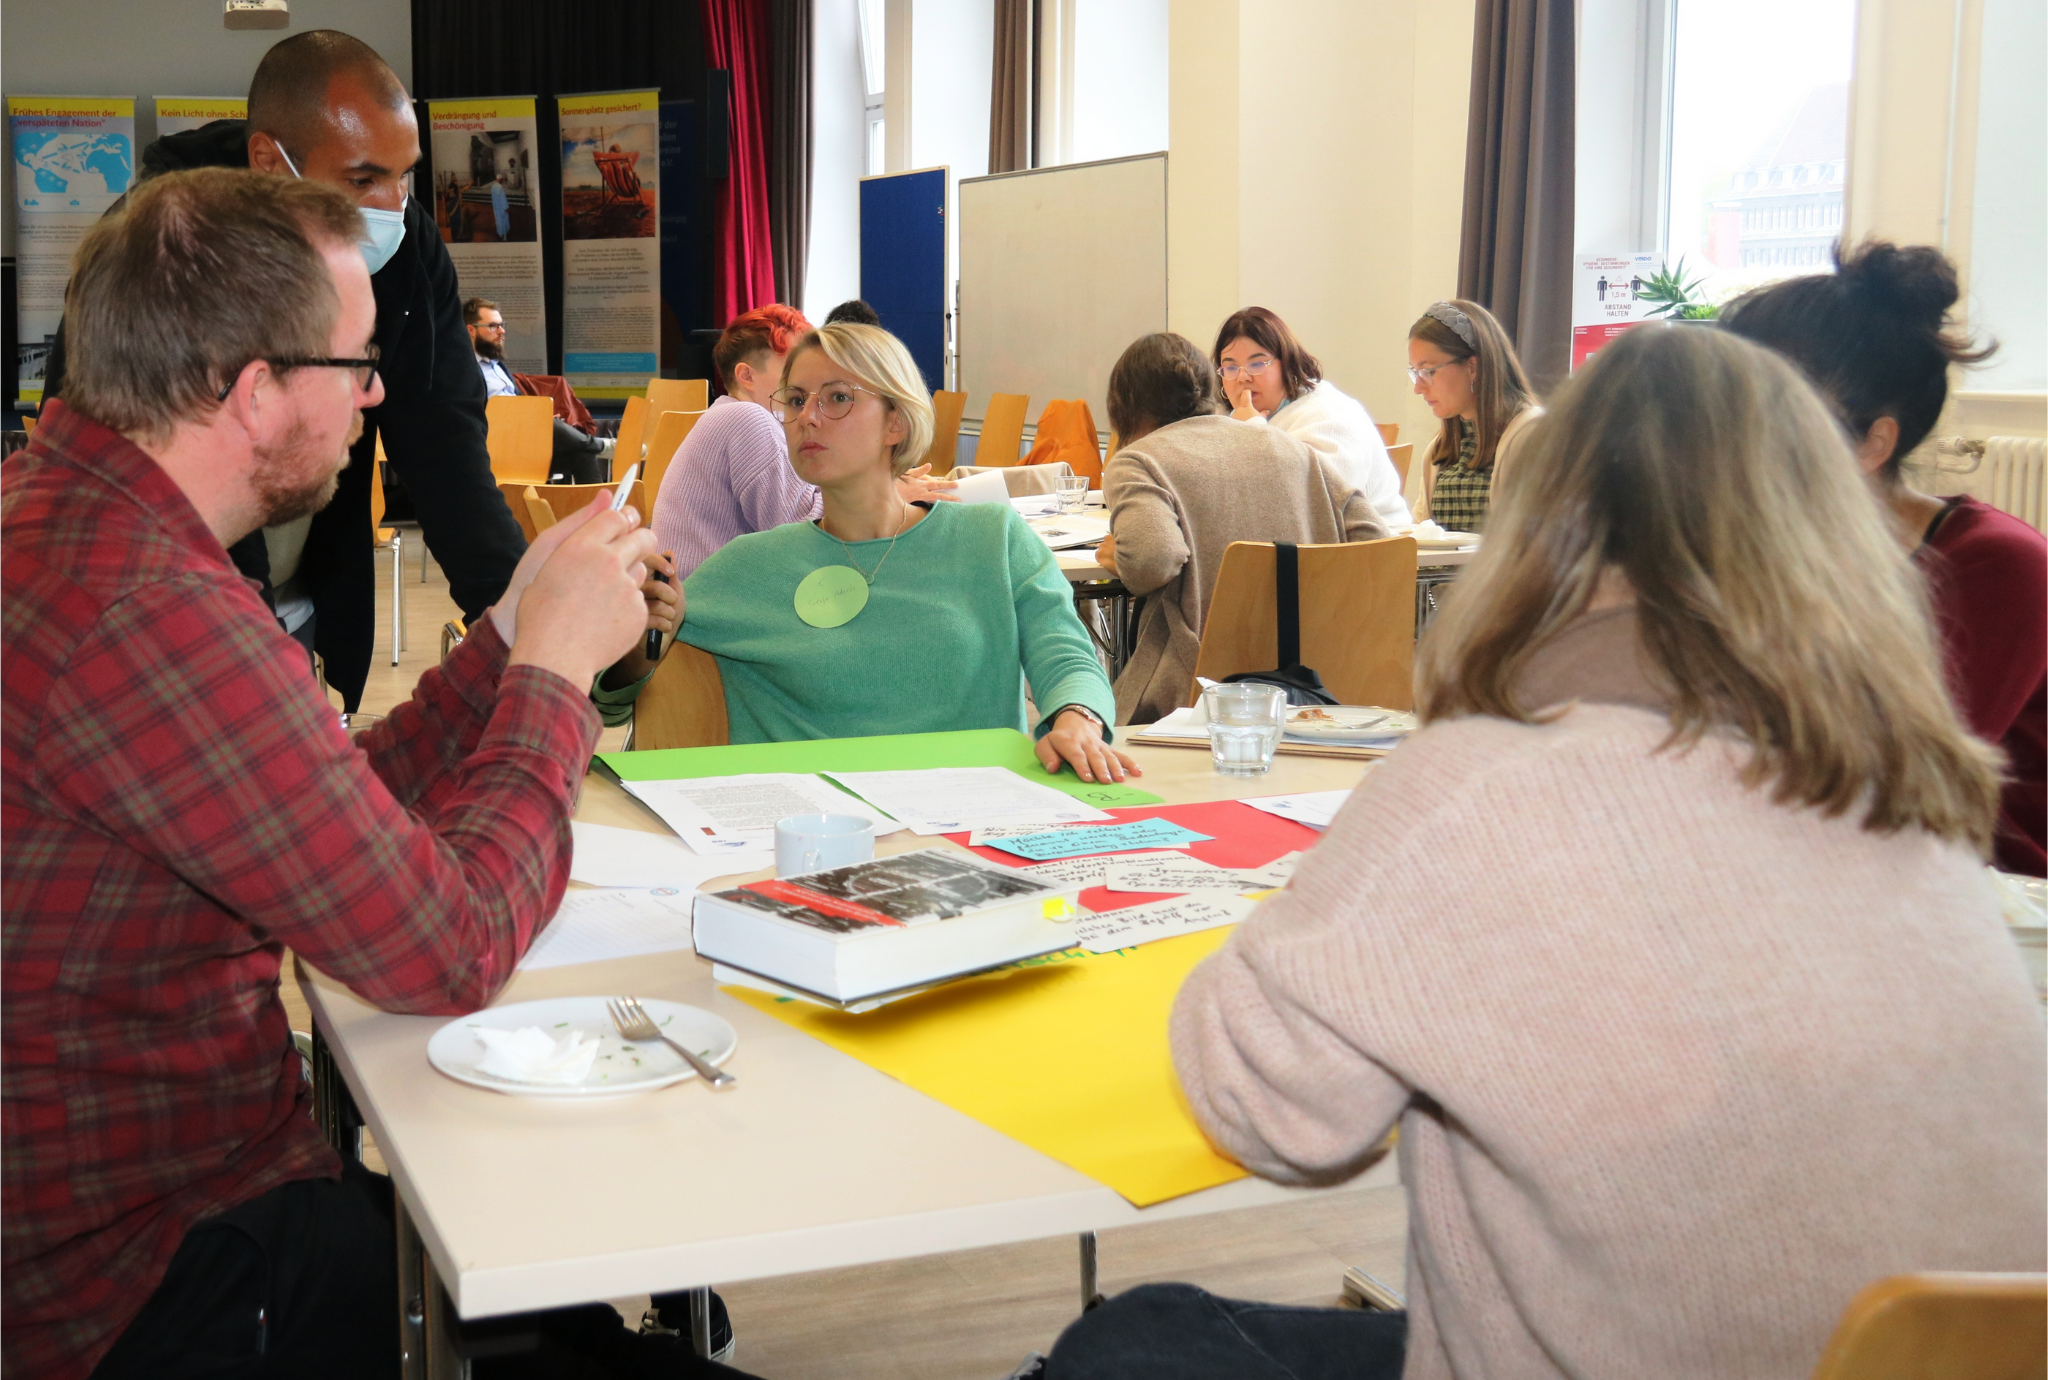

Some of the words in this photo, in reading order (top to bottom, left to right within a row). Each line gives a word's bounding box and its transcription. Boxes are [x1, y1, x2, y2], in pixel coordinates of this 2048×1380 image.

[13, 107, 44, 117] Frühes
[45, 108, 100, 119] Engagement
[102, 108, 117, 117] der
[161, 109, 181, 118] Kein
[183, 109, 204, 118] Licht
[206, 109, 228, 118] ohne
[230, 110, 249, 119] Scha
[561, 105, 604, 117] Sonnenplatz
[605, 102, 642, 114] gesichert?
[432, 111, 481, 122] Verdrängung
[482, 110, 497, 119] und
[433, 120, 485, 132] Beschönigung
